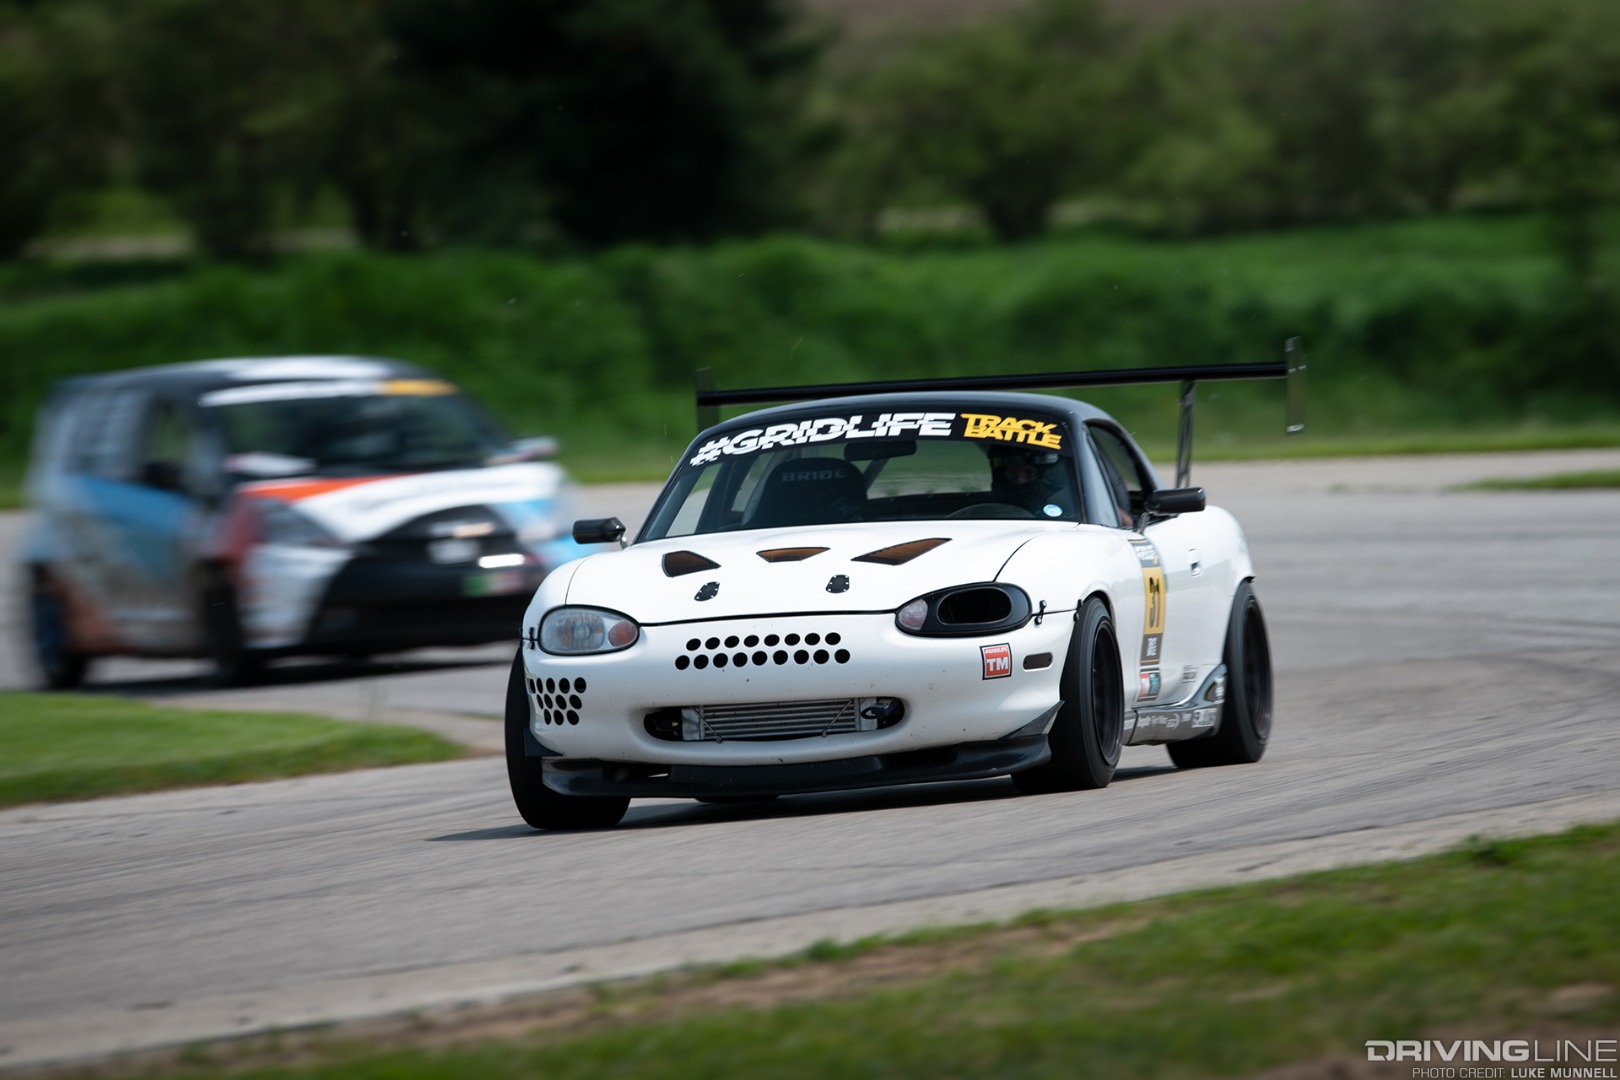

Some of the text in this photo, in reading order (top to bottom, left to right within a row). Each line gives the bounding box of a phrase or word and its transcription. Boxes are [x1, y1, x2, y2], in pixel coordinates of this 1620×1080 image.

[960, 413, 1059, 434] TRACK
[690, 413, 956, 467] #GRIDLIFE
[963, 424, 1062, 450] BATTLE
[986, 656, 1009, 672] TM
